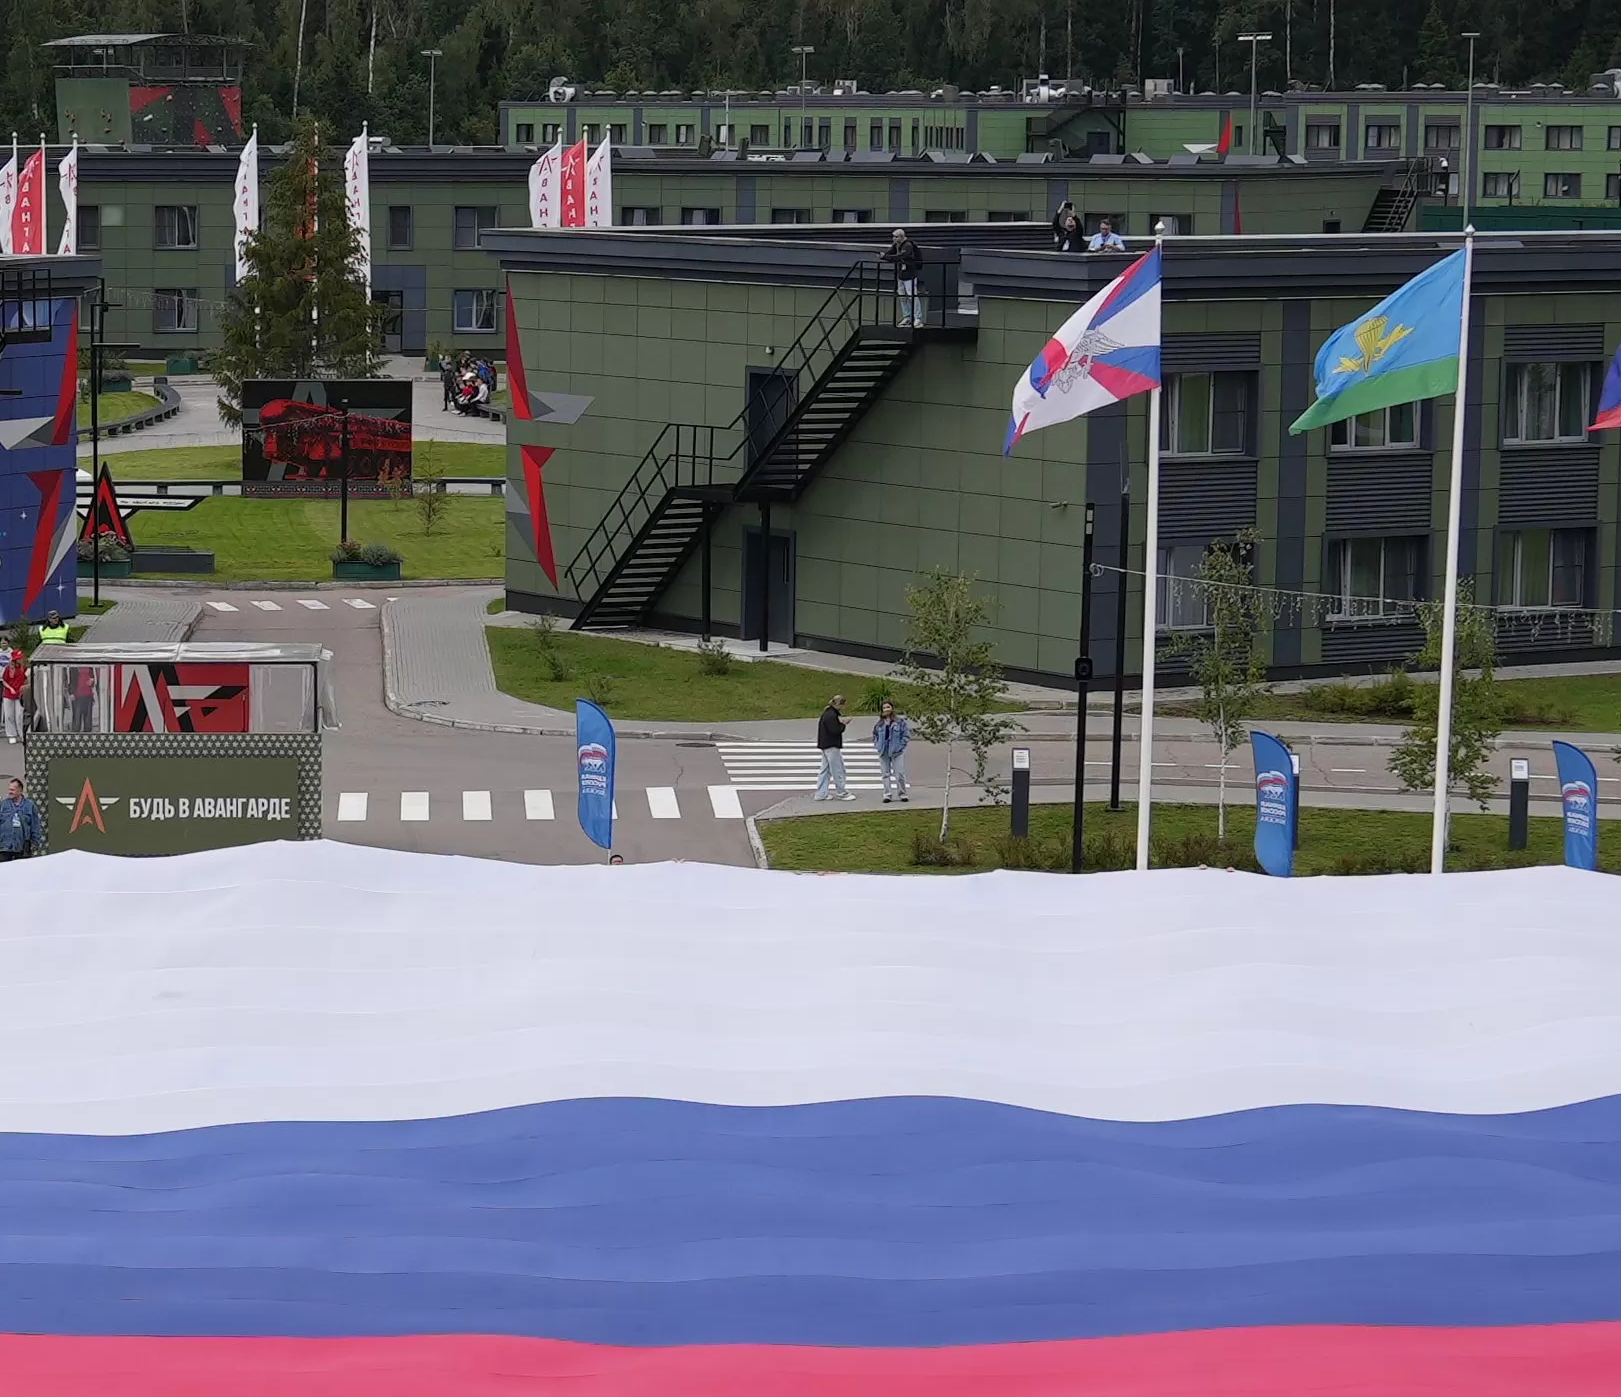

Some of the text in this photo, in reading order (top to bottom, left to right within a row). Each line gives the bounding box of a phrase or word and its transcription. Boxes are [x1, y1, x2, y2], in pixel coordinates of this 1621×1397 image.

[129, 797, 291, 821] БУДЬ В АВАНГАРДЕ
